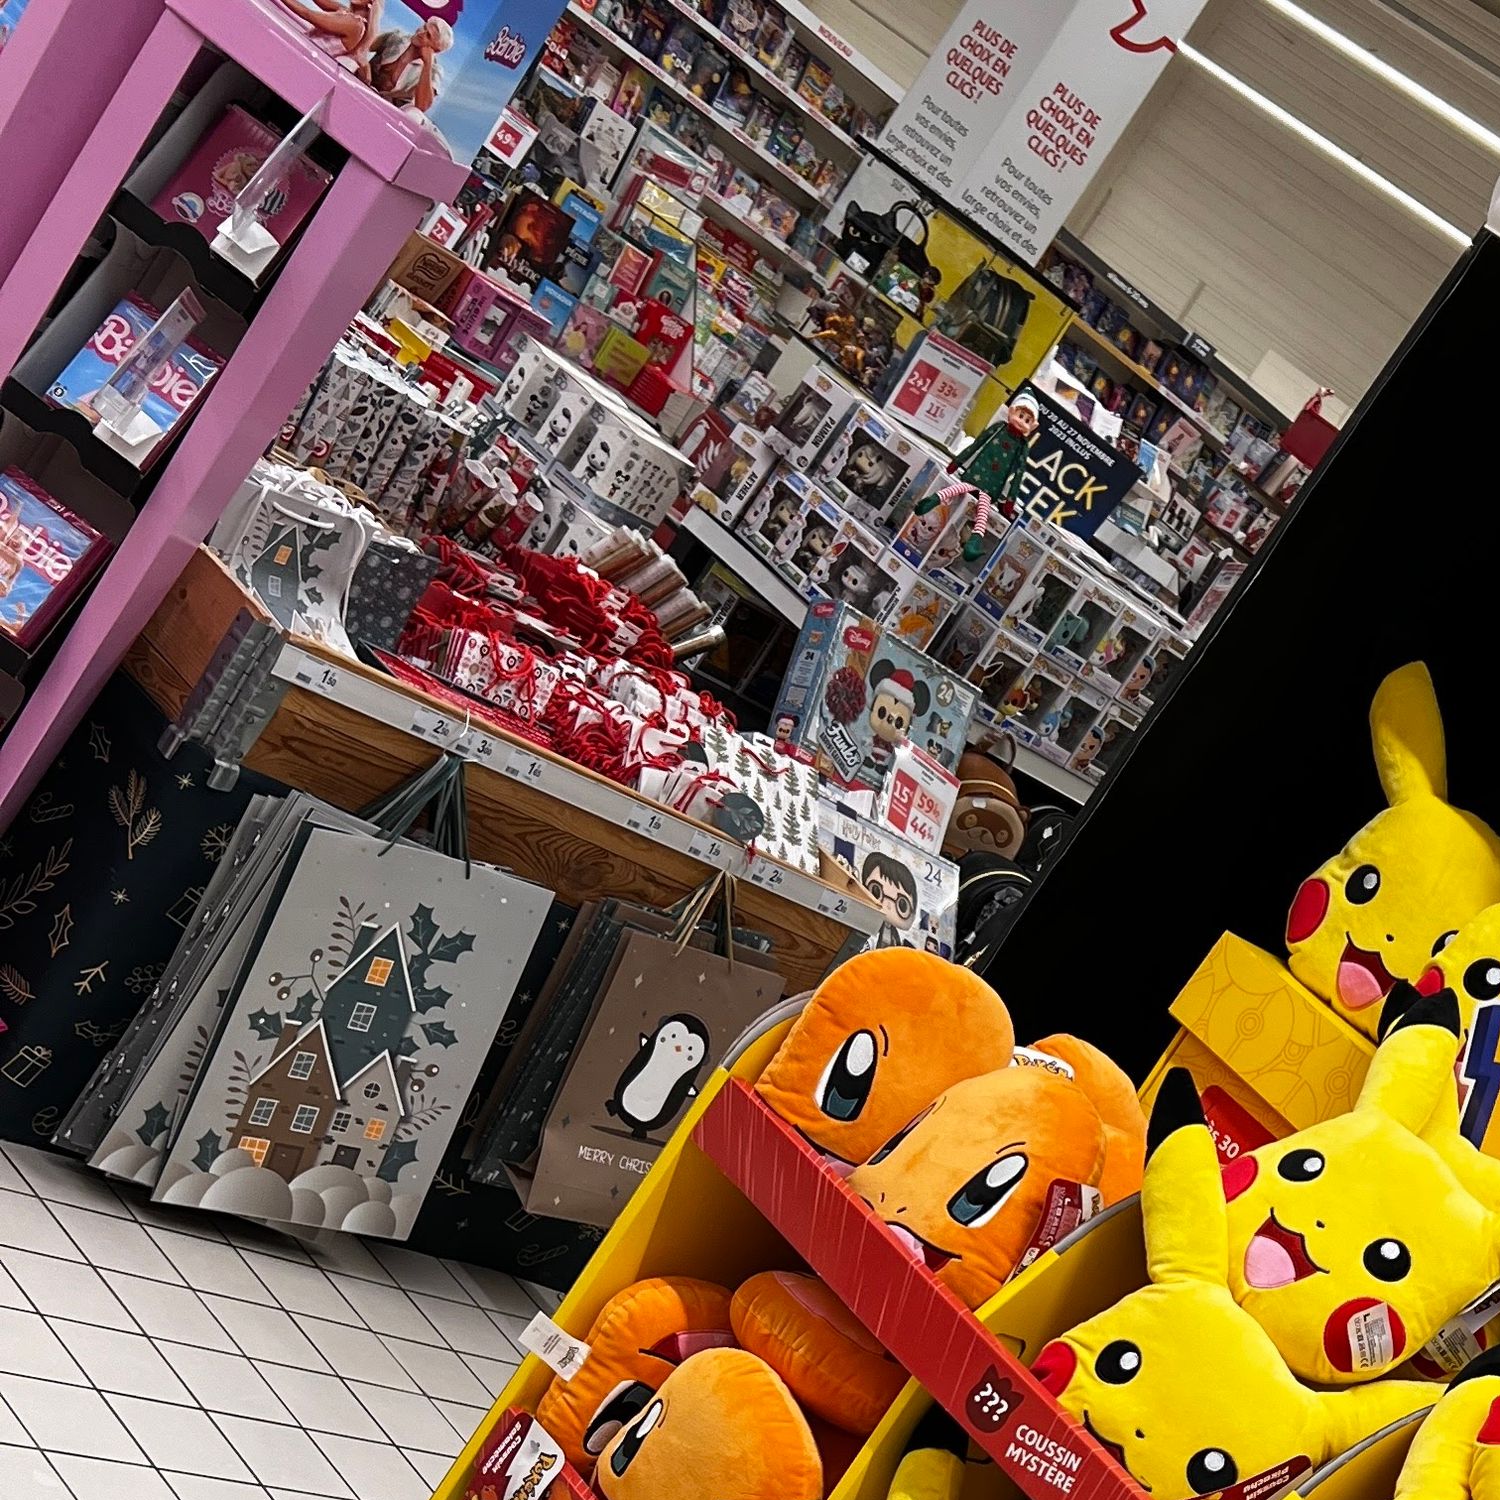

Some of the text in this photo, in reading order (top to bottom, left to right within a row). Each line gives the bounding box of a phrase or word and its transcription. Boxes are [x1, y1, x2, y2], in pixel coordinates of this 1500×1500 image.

[959, 34, 1012, 78] CHOIX EN
[972, 19, 1018, 60] PLUS DE
[945, 70, 977, 100] CLICS
[946, 48, 1004, 96] QUELQUES
[914, 112, 930, 128] vos
[921, 95, 969, 137] Pour toutes
[1040, 96, 1096, 149] CHOIX EN
[1053, 82, 1102, 131] PLUS DE
[901, 124, 953, 167] retrouvez un
[1026, 109, 1088, 166] QUELQUES
[1027, 135, 1060, 173] CLICS
[905, 145, 927, 169] choix
[938, 171, 955, 188] des
[994, 175, 1012, 193] vos
[1001, 157, 1054, 206] Pour toutes
[961, 189, 988, 216] large
[986, 210, 1012, 237] choix
[1011, 230, 1023, 244] et
[1021, 238, 1039, 256] des
[980, 185, 1023, 224] retrouvez
[1023, 220, 1038, 235] un
[1057, 418, 1115, 468] AU 27 NOVEMBRE
[1063, 436, 1092, 461] INCLUS
[1025, 433, 1108, 511] LACK
[1015, 471, 1078, 527] EEK
[923, 861, 943, 887] 24
[578, 1143, 653, 1175] MERRY CHRIS
[1218, 1134, 1241, 1160] 30
[973, 1383, 1009, 1422] ???
[1005, 1442, 1077, 1494] MYSTÈRE
[1015, 1424, 1083, 1473] COUSSIN
